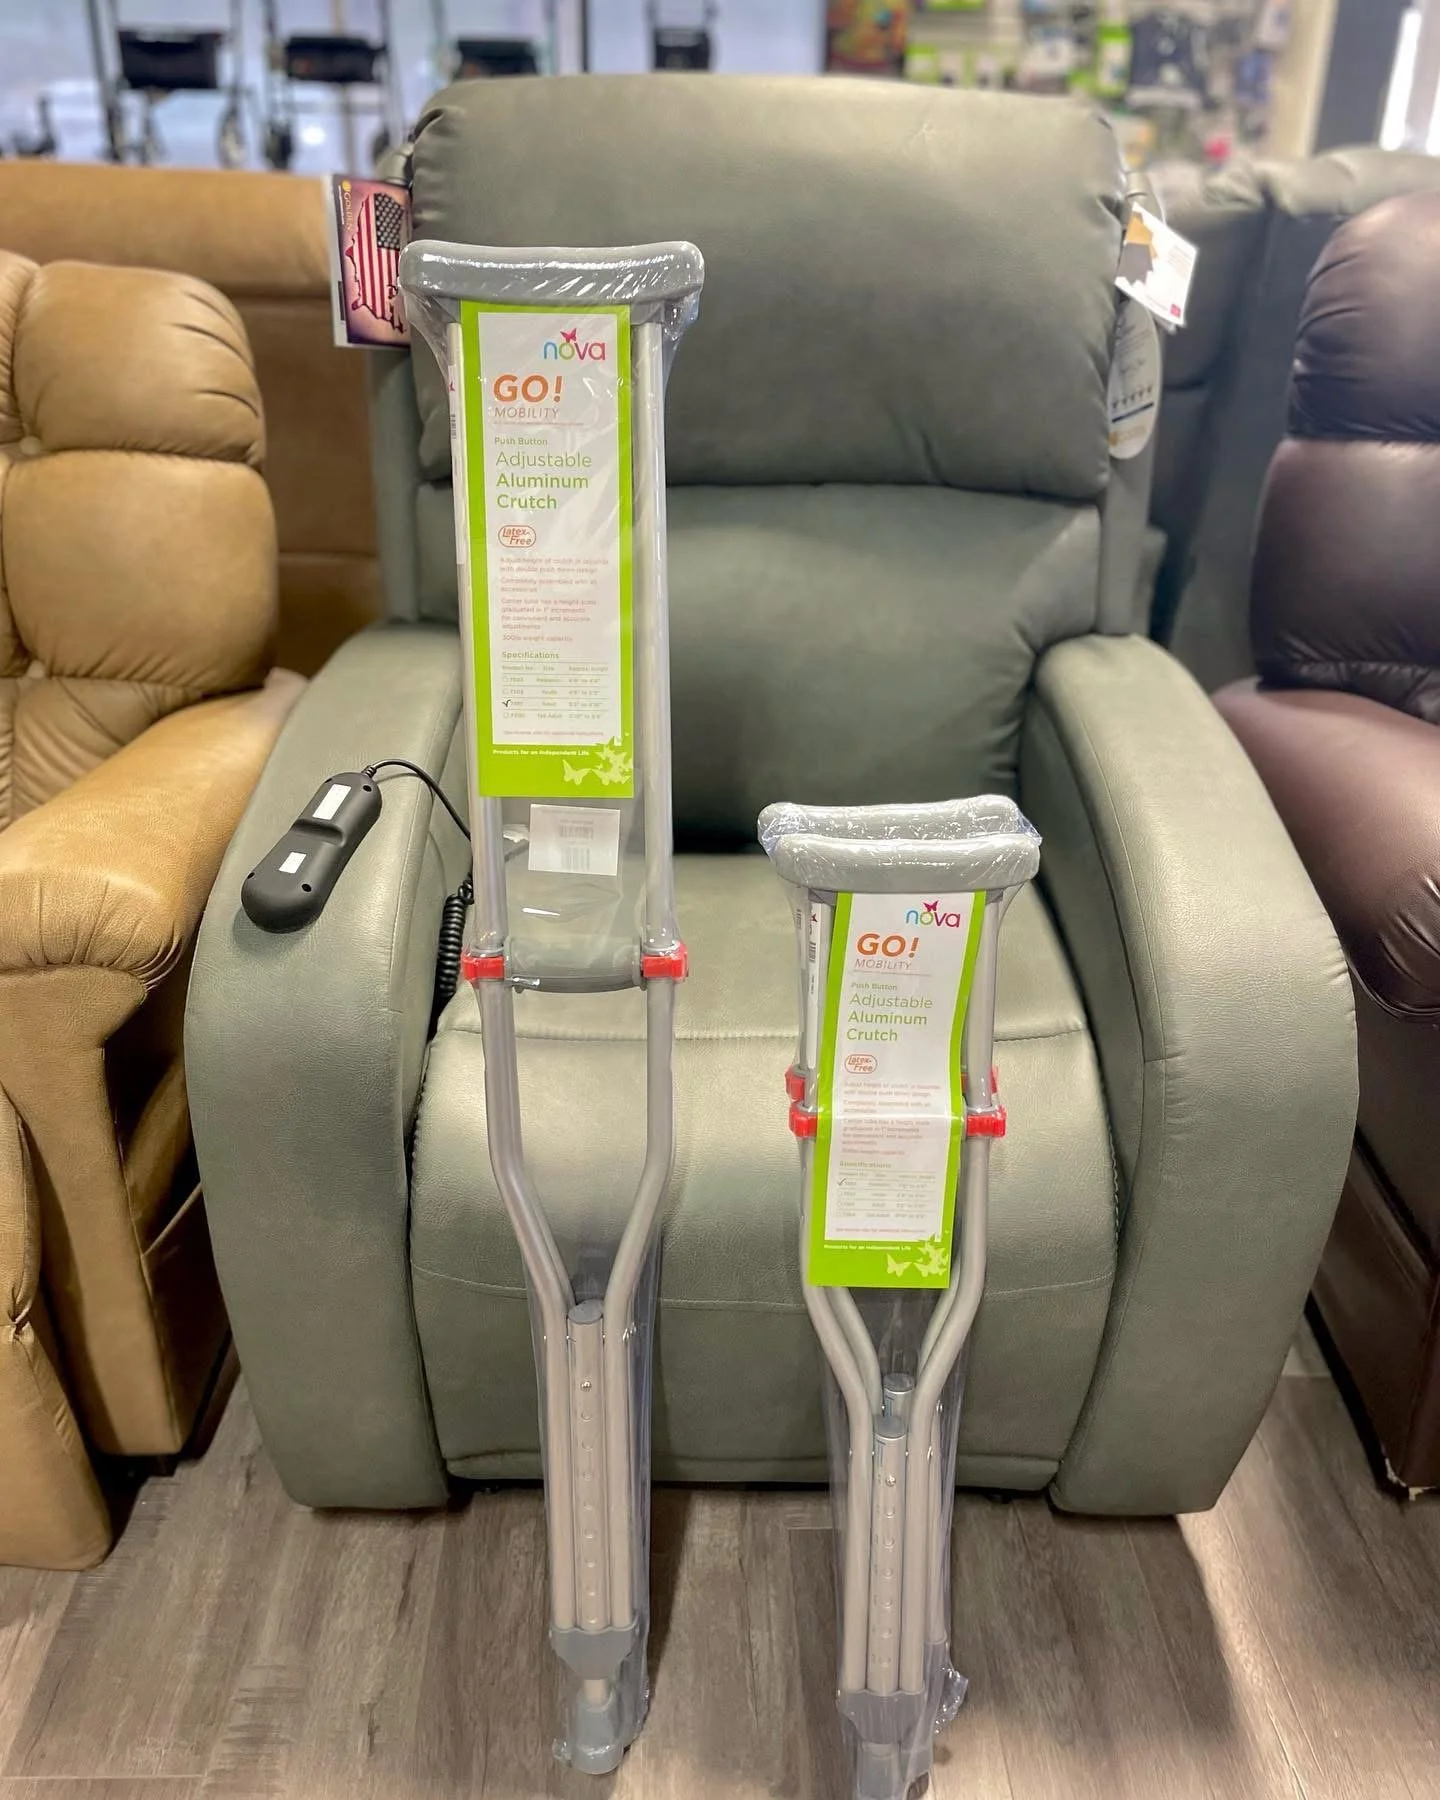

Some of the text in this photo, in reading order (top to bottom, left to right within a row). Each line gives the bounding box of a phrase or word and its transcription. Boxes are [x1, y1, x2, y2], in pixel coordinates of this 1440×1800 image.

[543, 341, 606, 361] nova
[493, 374, 563, 403] GO!
[494, 407, 560, 418] MOBILITY
[494, 436, 548, 446] Push Button
[495, 452, 592, 469] Adjustable
[496, 473, 589, 489] Aluminum
[496, 494, 557, 510] Crutch
[509, 536, 532, 546] Free
[502, 651, 560, 660] Specifications
[906, 909, 961, 927] nova
[857, 933, 920, 958] GO!
[855, 958, 912, 970] MOBILITY
[851, 982, 870, 990] Push
[850, 993, 933, 1009] Adjustable
[848, 1010, 927, 1025] Aluminum
[847, 1028, 898, 1041] Crutch
[853, 1064, 873, 1072] Free
